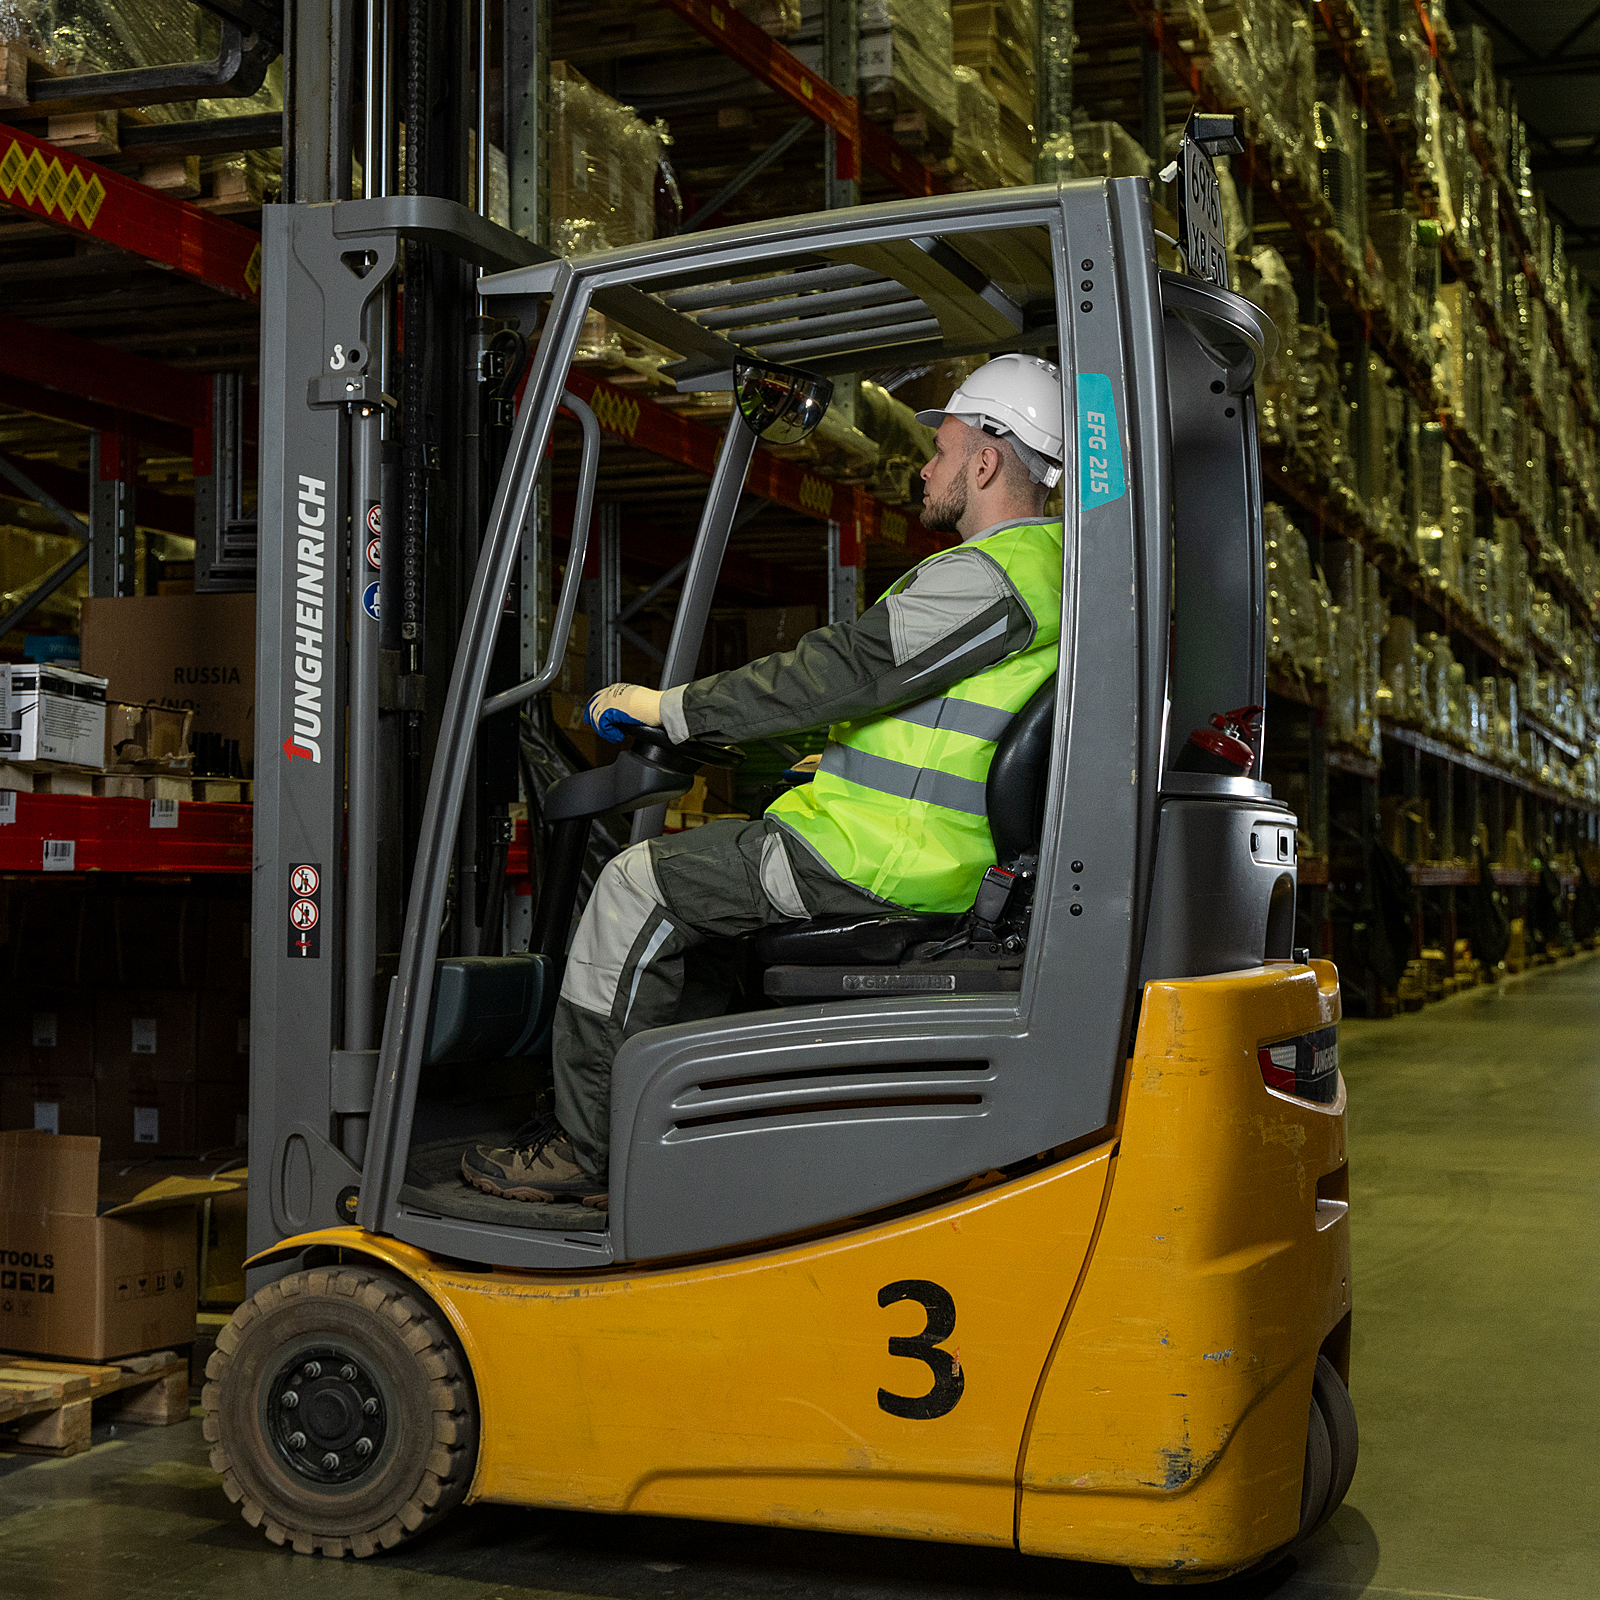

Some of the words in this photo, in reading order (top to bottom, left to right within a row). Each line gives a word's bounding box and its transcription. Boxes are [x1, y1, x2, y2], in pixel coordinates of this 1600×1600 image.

[1211, 245, 1225, 288] 50
[1087, 410, 1107, 450] EFG
[1089, 455, 1109, 494] 215
[292, 474, 326, 764] JUNGHEINRICH
[174, 666, 241, 684] RUSSIA
[0, 1249, 55, 1269] TOOLS
[877, 1279, 965, 1420] 3
